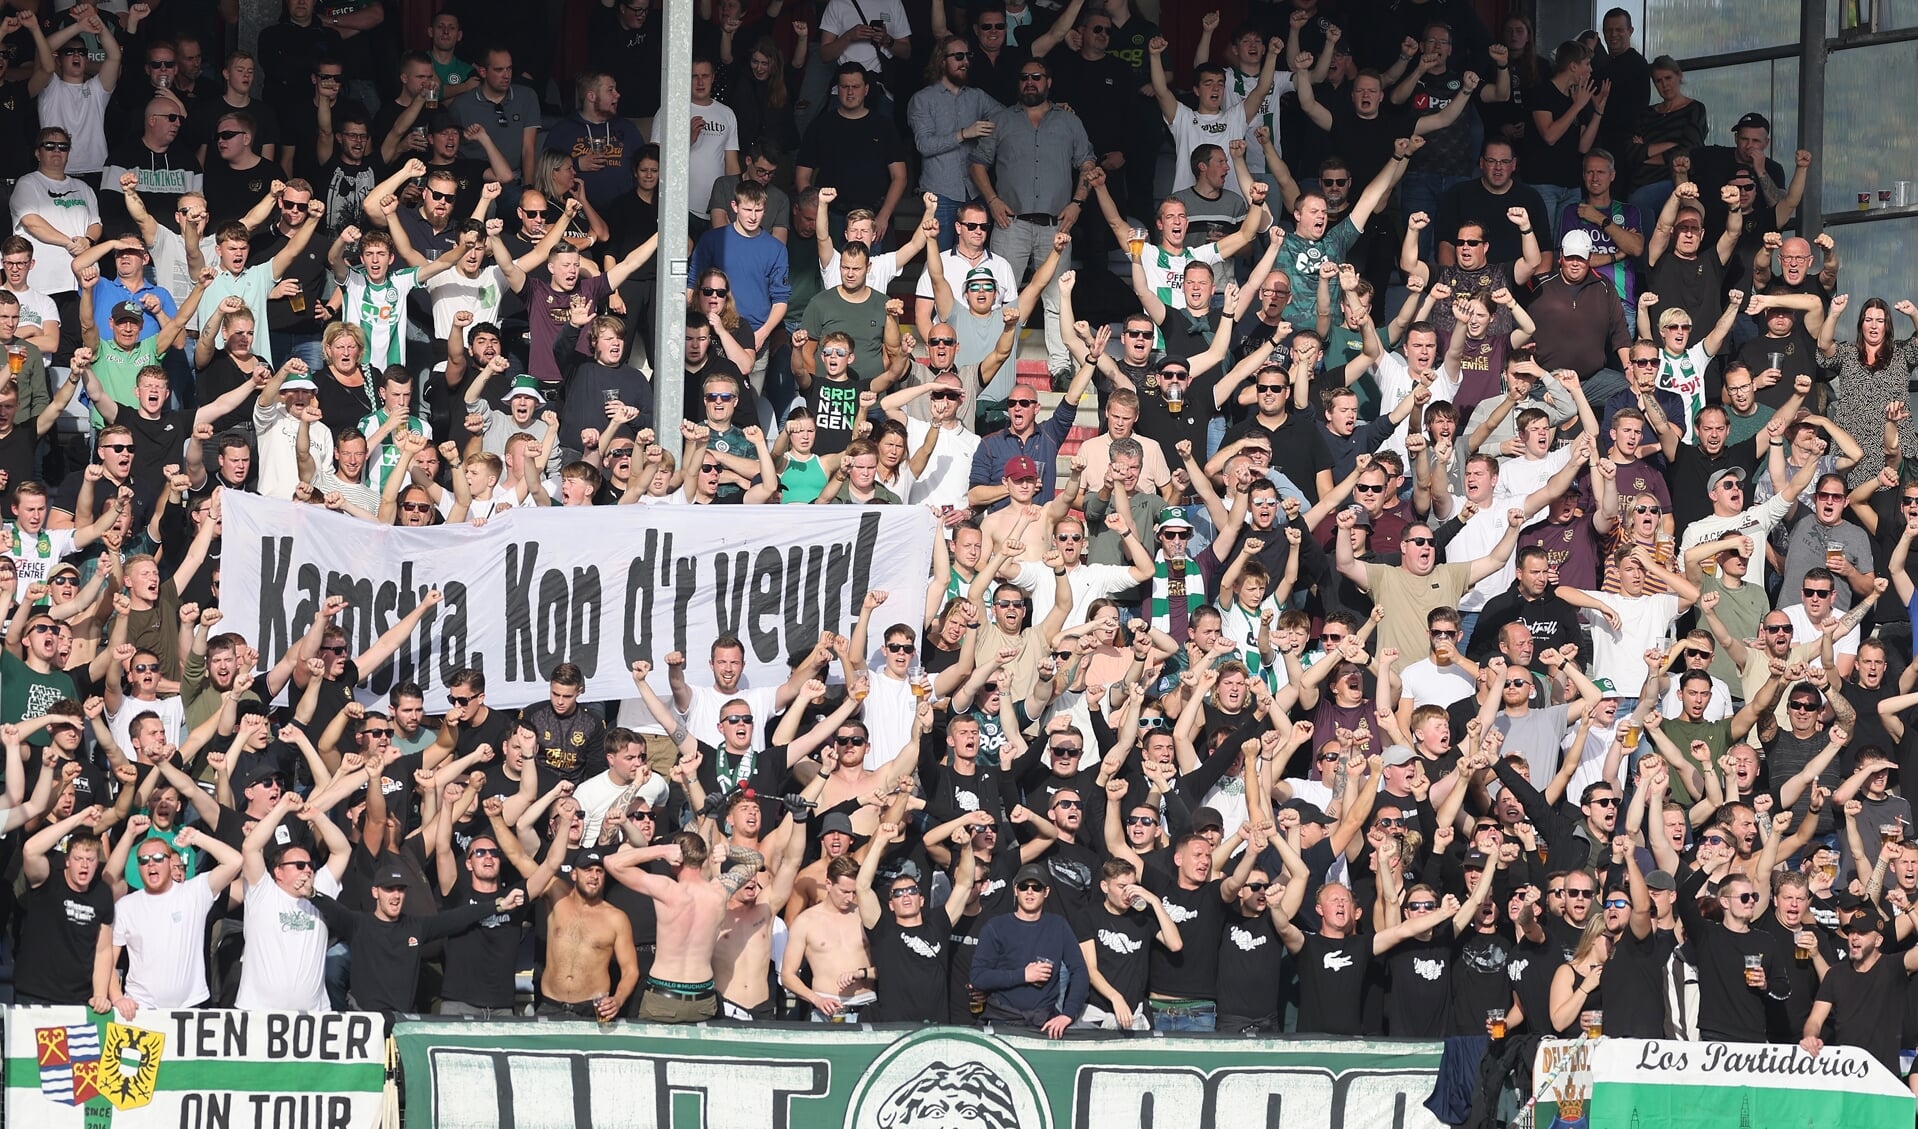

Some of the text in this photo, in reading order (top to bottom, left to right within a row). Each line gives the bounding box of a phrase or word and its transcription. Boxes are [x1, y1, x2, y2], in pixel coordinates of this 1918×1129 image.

[88, 53, 105, 62] FICE
[704, 120, 725, 134] alty
[138, 170, 185, 187] GRONINGEN
[1166, 271, 1184, 282] OFF
[1461, 361, 1489, 371] ENTRE
[819, 386, 856, 402] GRO
[817, 401, 855, 415] NIN
[815, 413, 855, 430] GEN
[15, 558, 46, 571] OFFICE
[504, 541, 602, 693] Kop
[714, 512, 882, 664] veur!
[171, 1011, 372, 1060] TEN BOER
[1636, 1040, 1870, 1079] Los Partidarios
[84, 1106, 112, 1119] SINCE
[180, 1093, 352, 1129] ON TOUR
